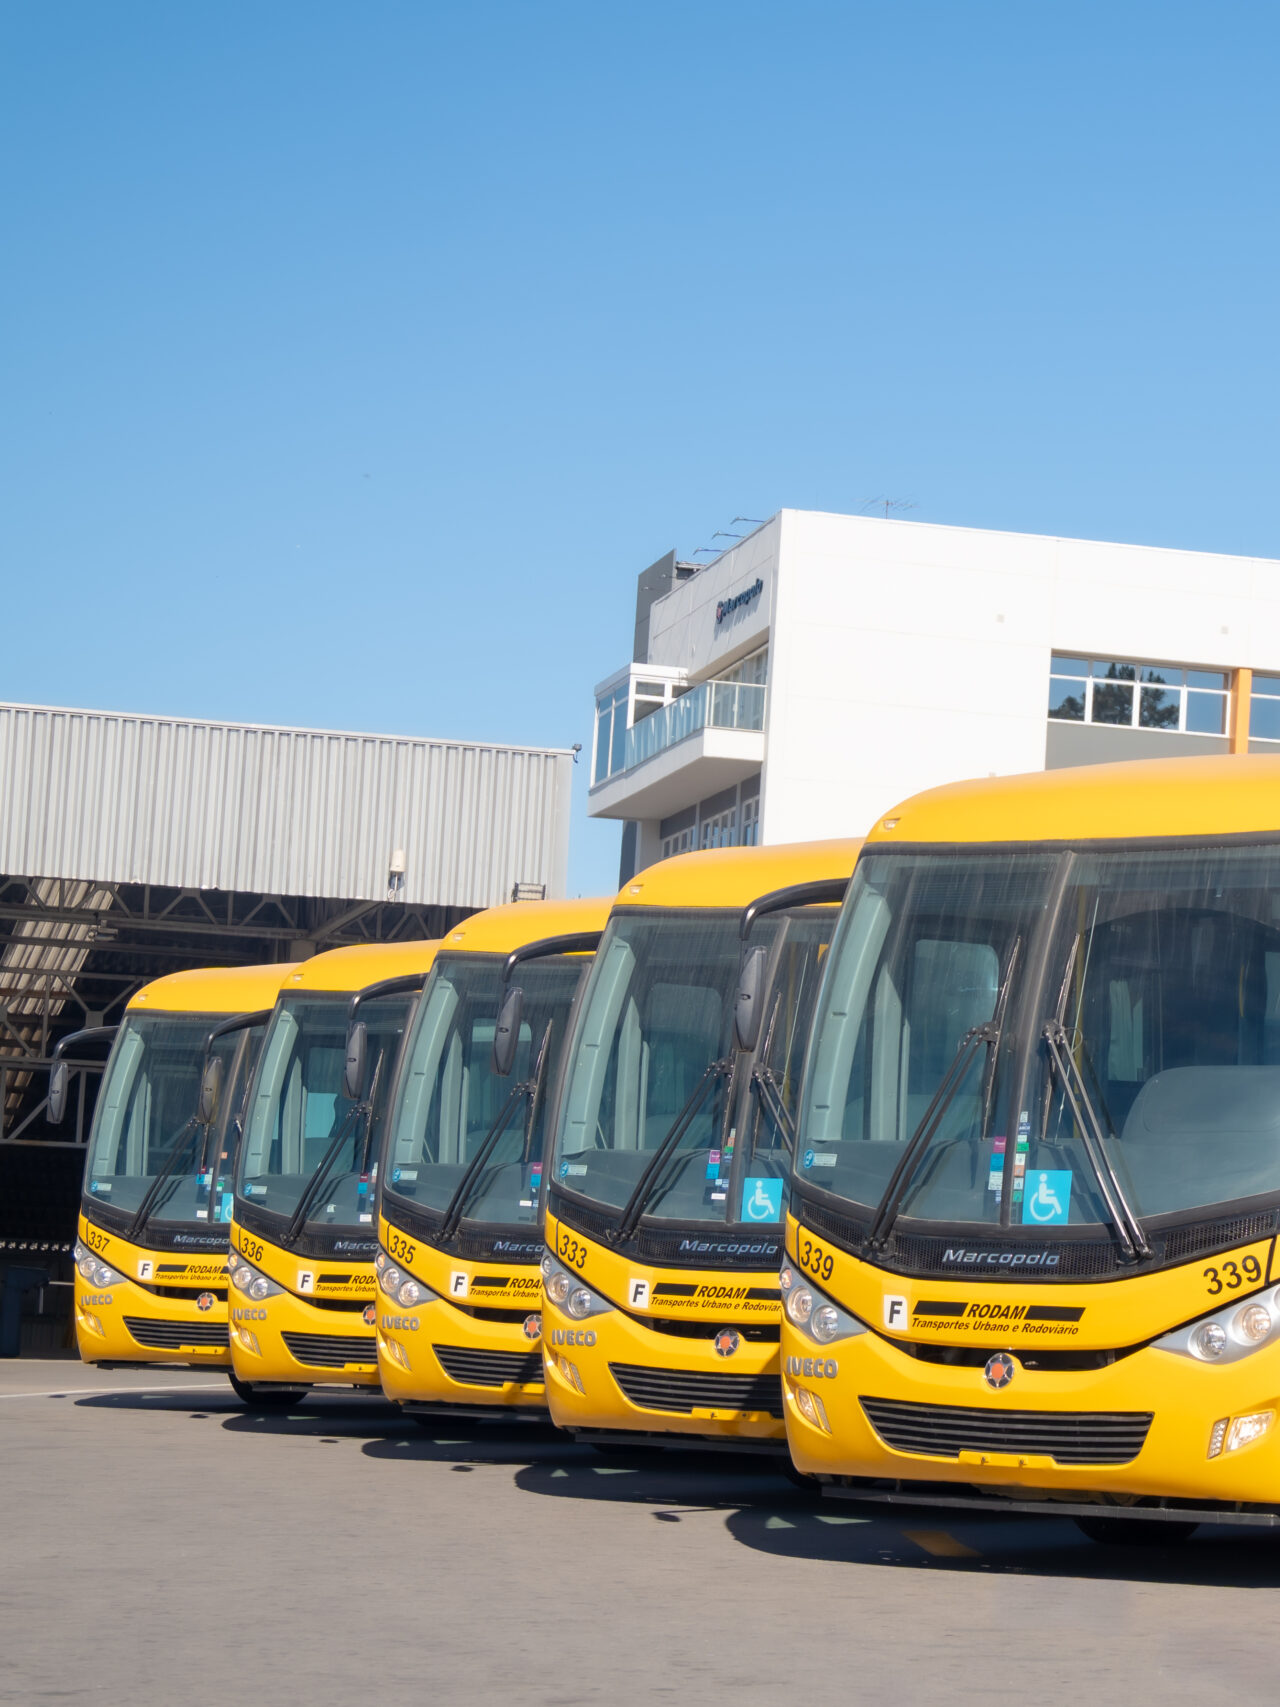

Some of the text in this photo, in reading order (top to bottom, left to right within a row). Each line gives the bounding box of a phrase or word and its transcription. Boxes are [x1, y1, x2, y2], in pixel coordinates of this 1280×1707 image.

[88, 1231, 111, 1252] 337
[241, 1237, 264, 1262] 336
[389, 1235, 416, 1265] 335
[679, 1239, 778, 1255] Marcopolo
[559, 1234, 588, 1269] 333
[942, 1249, 1060, 1267] Marcopolo
[801, 1240, 835, 1281] 339
[140, 1263, 150, 1277] F
[155, 1273, 190, 1281] Transportes
[187, 1265, 221, 1274] RODAM
[1203, 1255, 1262, 1295] 339
[300, 1273, 311, 1289] F
[316, 1285, 353, 1293] Transportes
[453, 1275, 465, 1292] F
[80, 1293, 113, 1306] IVECO
[470, 1288, 539, 1298] Transportes Urbano
[632, 1283, 645, 1302] F
[697, 1285, 748, 1300] RODAM
[651, 1297, 699, 1308] Transportes
[701, 1299, 733, 1310] Urbano
[741, 1302, 781, 1312] Rodoviár
[888, 1301, 903, 1323] F
[967, 1302, 1026, 1320] RODAM
[232, 1308, 268, 1321] IVECO
[381, 1314, 420, 1331] IVECO
[911, 1317, 1079, 1336] Transportes Urbano e Rodoviário
[551, 1328, 597, 1347] IVECO
[786, 1355, 839, 1379] IVECO
